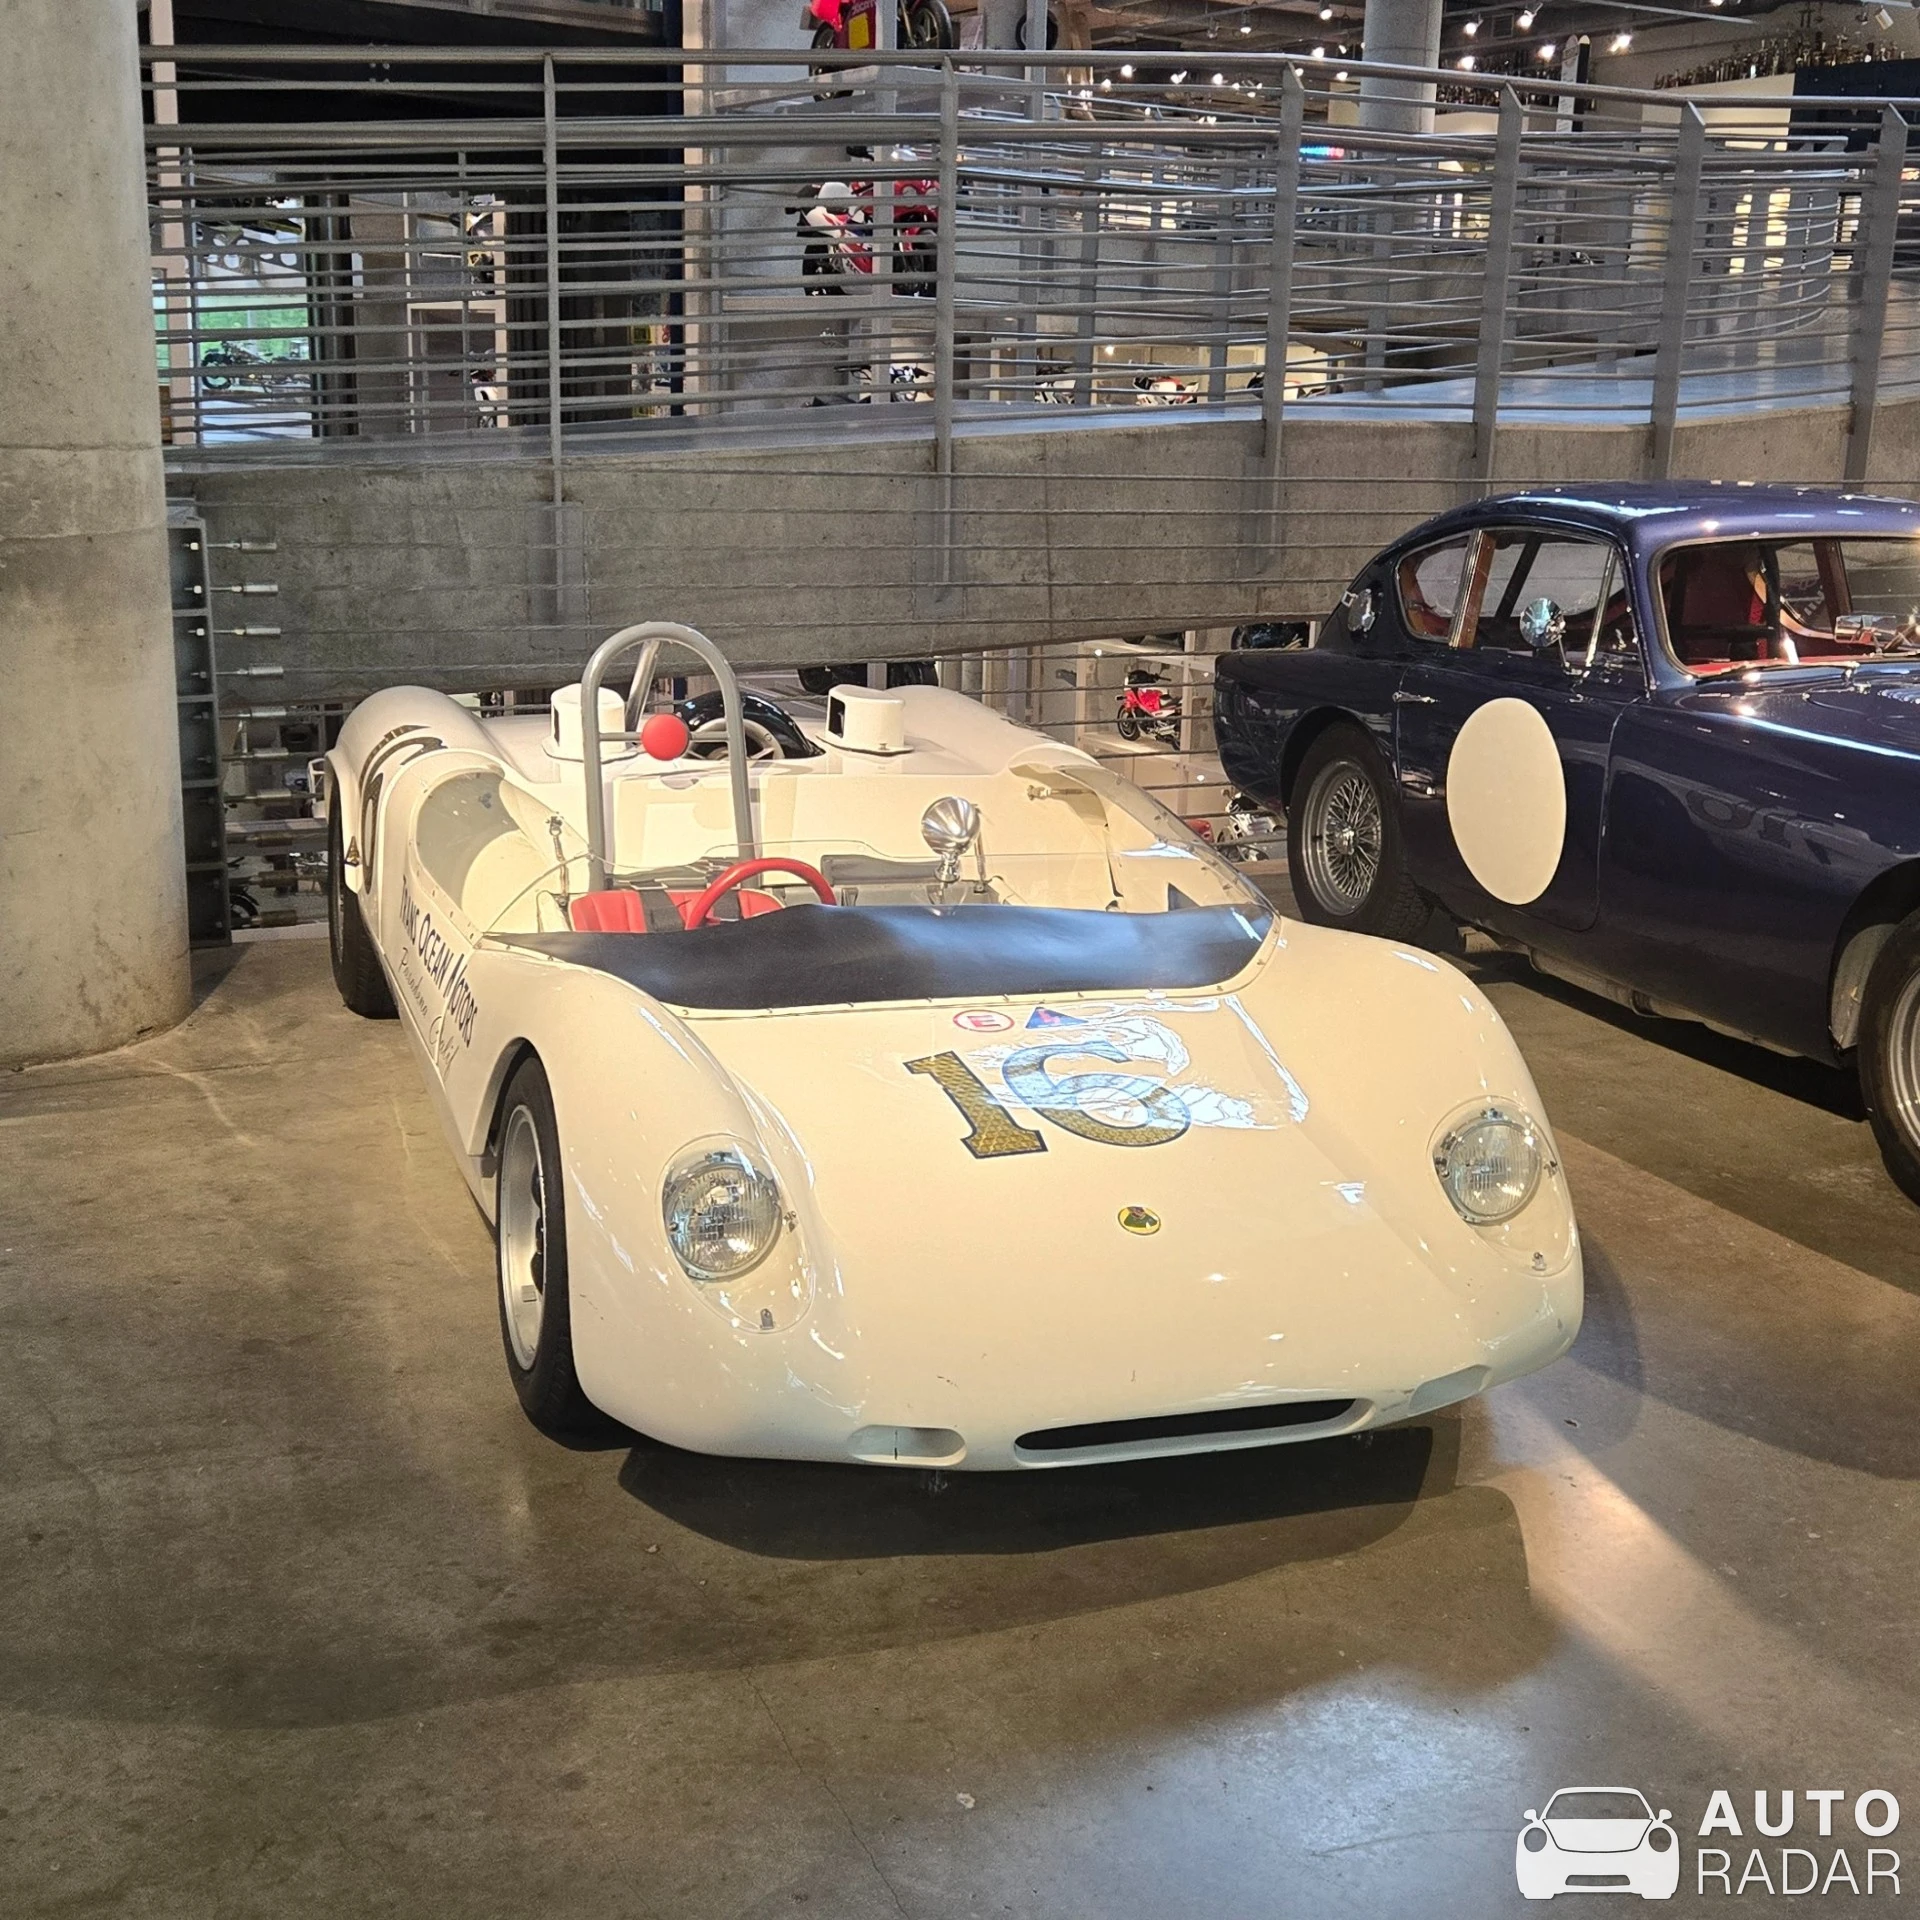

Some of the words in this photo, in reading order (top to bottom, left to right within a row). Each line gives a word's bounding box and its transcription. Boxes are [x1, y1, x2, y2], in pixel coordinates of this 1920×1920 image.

[400, 874, 420, 945] TRANS
[418, 912, 454, 990] OCEAN
[443, 953, 478, 1048] MOTORS
[902, 1040, 1192, 1159] 16
